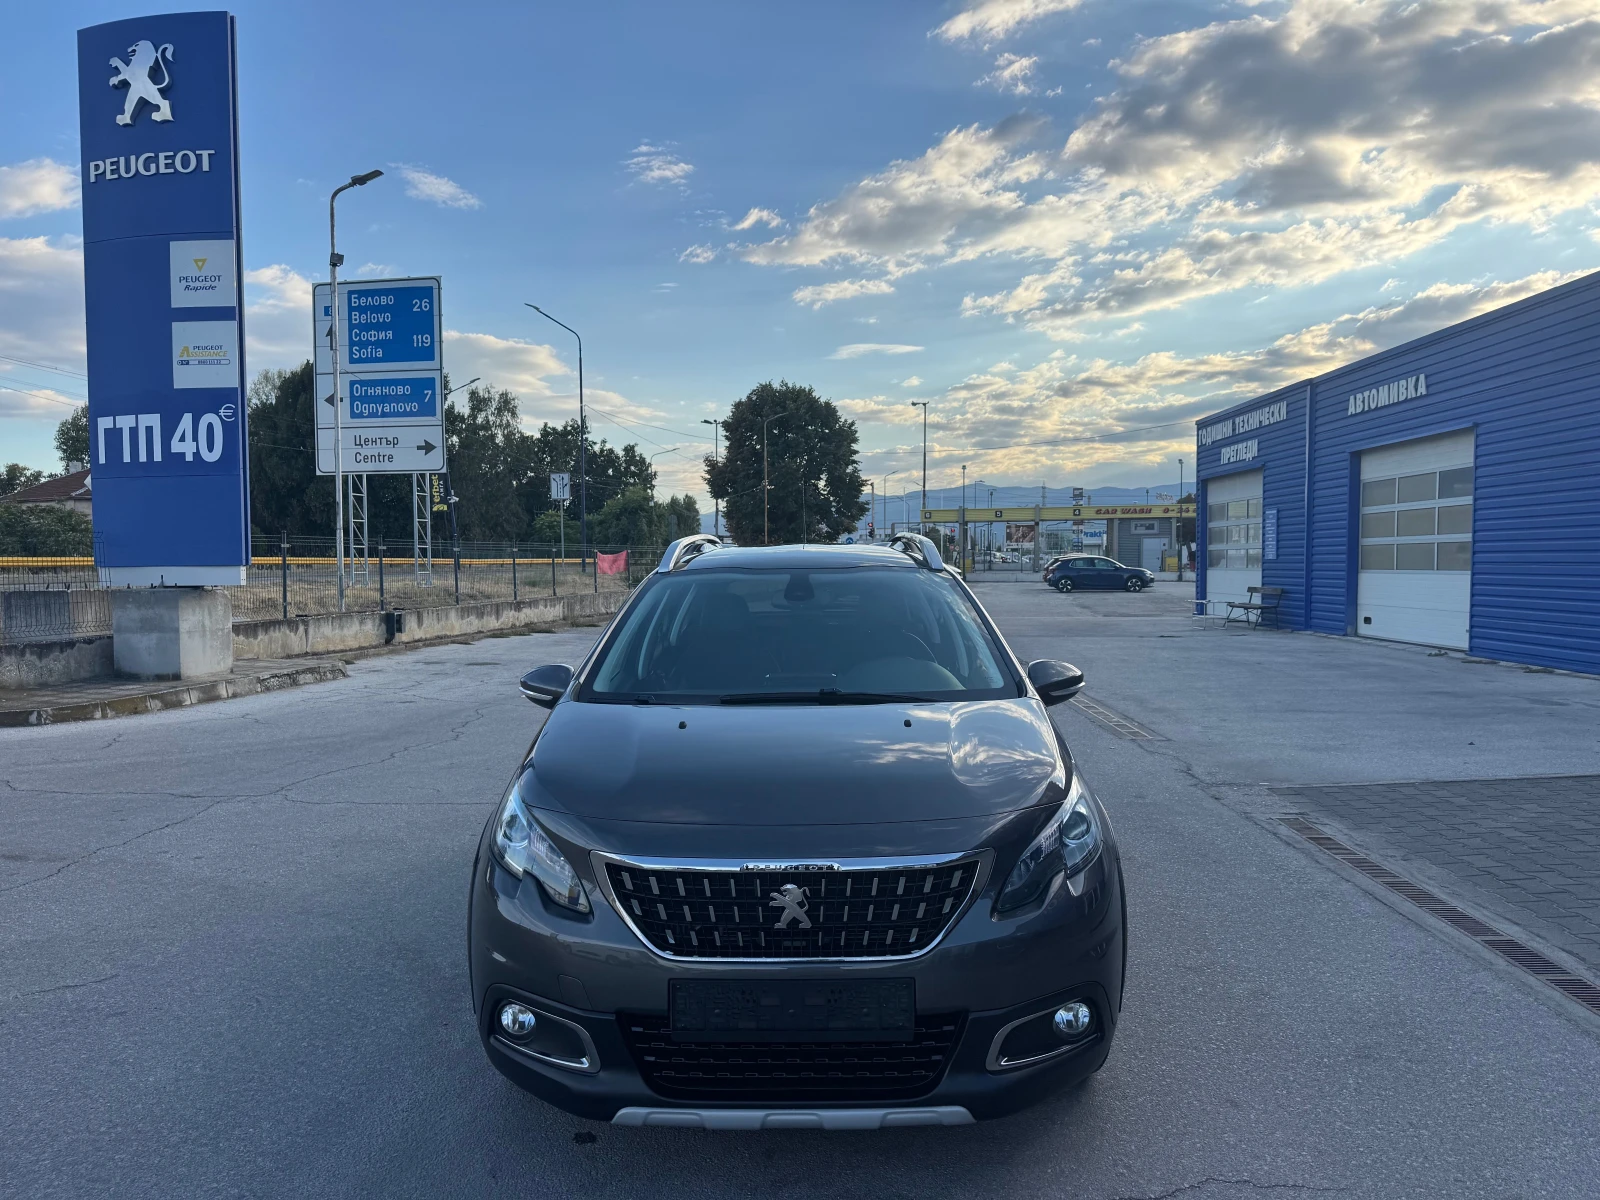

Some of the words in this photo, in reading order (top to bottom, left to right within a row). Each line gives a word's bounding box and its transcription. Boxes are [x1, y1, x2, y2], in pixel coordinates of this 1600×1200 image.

[89, 150, 215, 183] PEUGEOT
[178, 274, 222, 284] PEUGEOT
[184, 284, 217, 292] Rapide
[351, 295, 394, 307] Белово
[412, 299, 430, 312] 26
[351, 311, 391, 324] Belovo
[352, 329, 393, 342] София
[412, 334, 431, 347] 119
[352, 346, 383, 358] Sofia
[353, 384, 411, 397] Огняново
[424, 390, 432, 402] 7
[1347, 373, 1427, 416] АВТОМИВКА
[353, 401, 419, 416] Ognyanovo
[1198, 419, 1233, 446] ГОДИШНИ
[1235, 400, 1287, 435] ТЕХНИЧЕСКИ
[97, 414, 162, 464] ГТП
[354, 434, 399, 449] Център
[354, 451, 394, 464] Centre
[1220, 438, 1259, 465] ПРЕГЛЕДИ
[431, 474, 441, 503] efbet
[1074, 508, 1080, 516] 4
[1121, 507, 1153, 515] WASH
